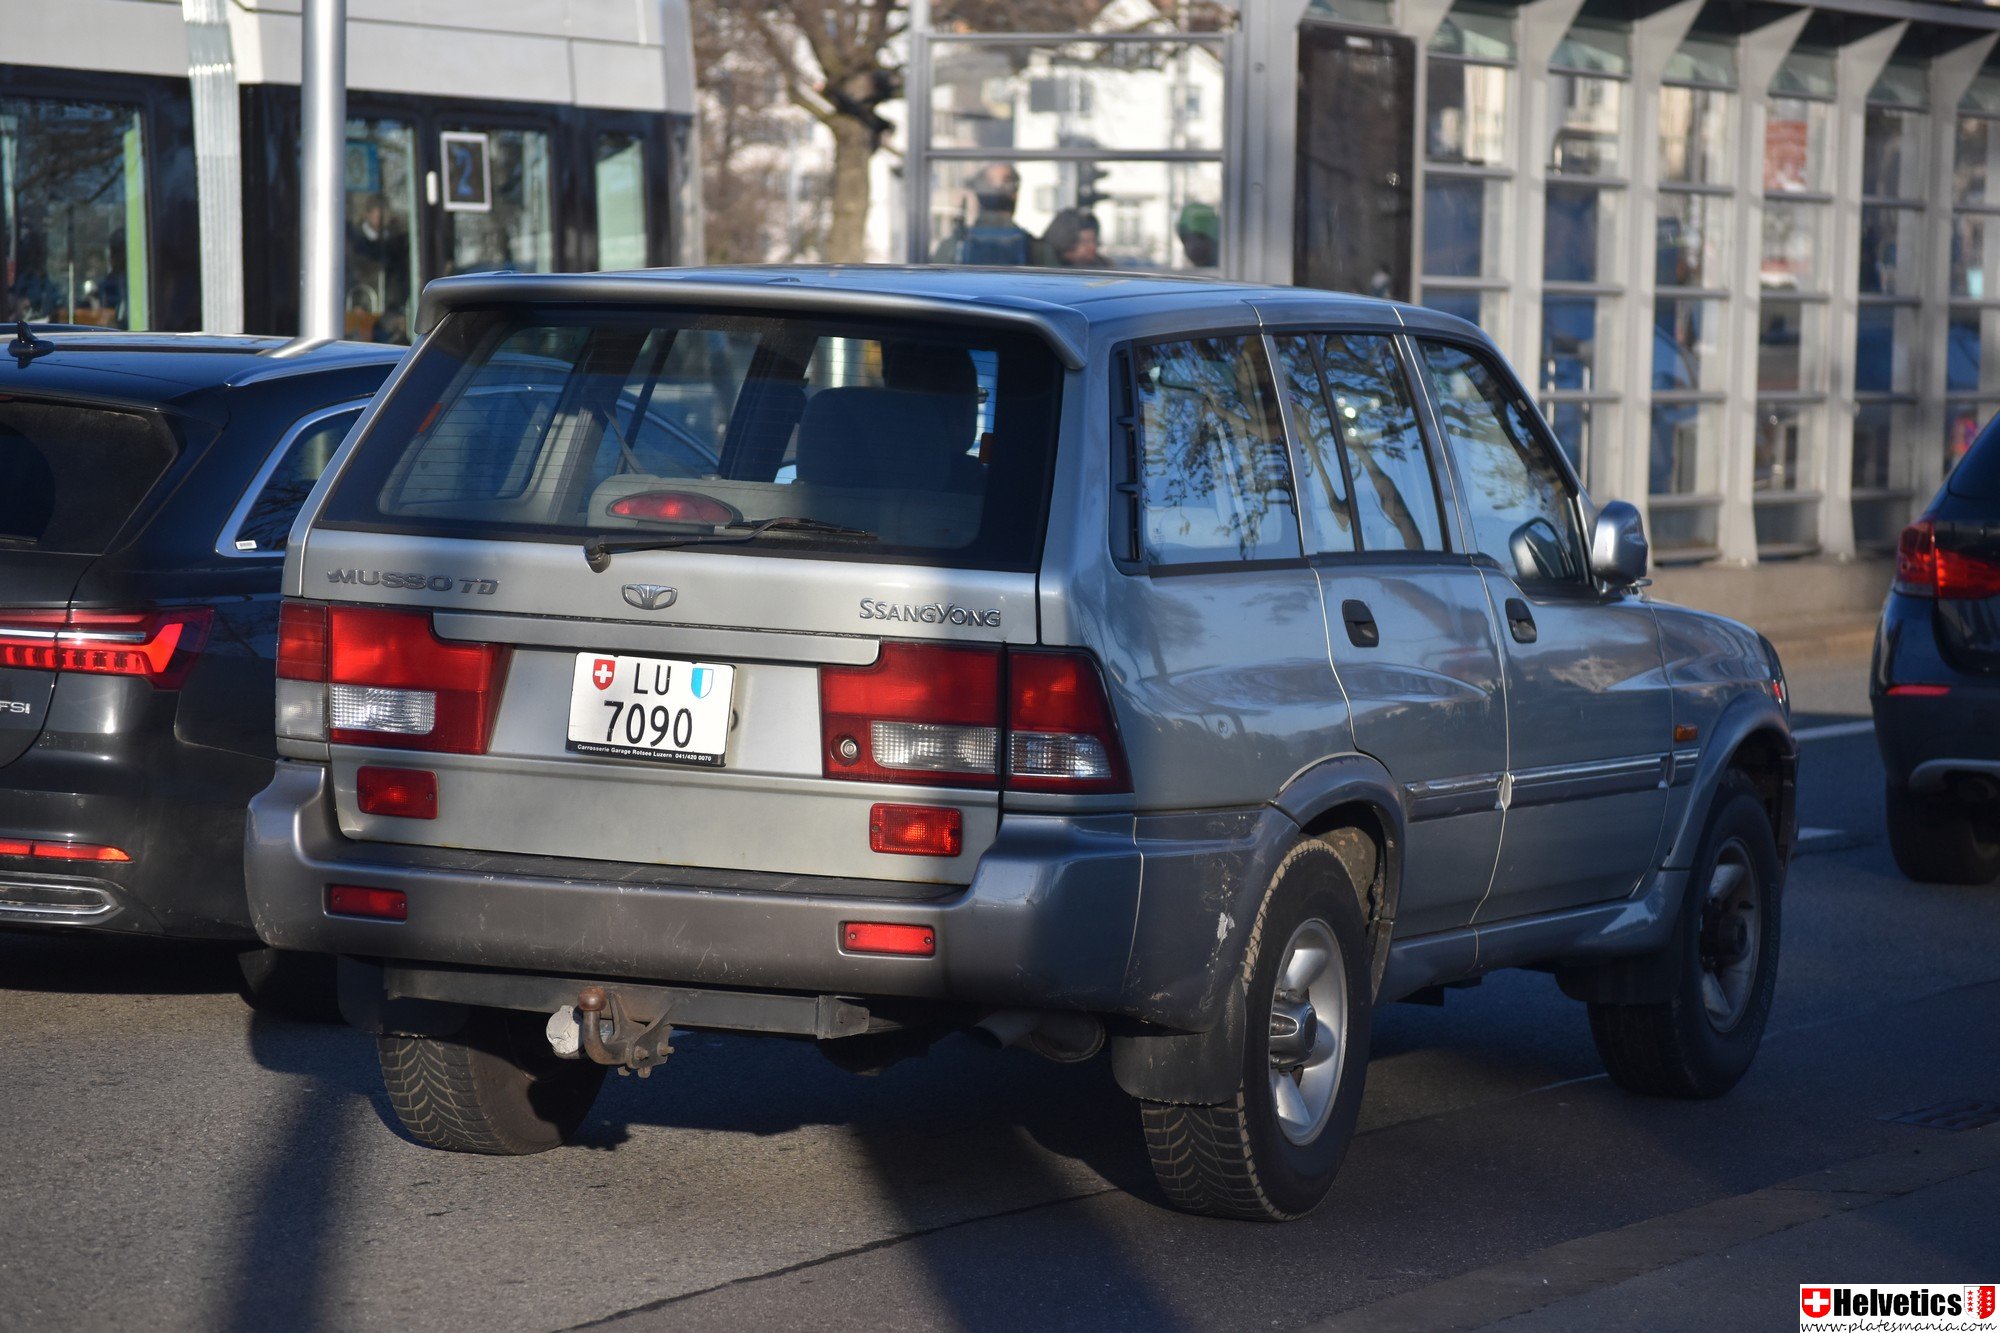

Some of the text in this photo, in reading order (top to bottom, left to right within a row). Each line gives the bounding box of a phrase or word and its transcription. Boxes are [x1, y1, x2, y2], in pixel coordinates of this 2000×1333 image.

[327, 568, 500, 595] MUSSO TD
[633, 662, 672, 696] LU
[603, 699, 693, 749] 7090
[577, 743, 610, 753] Carrosserie
[610, 747, 632, 755] Garage
